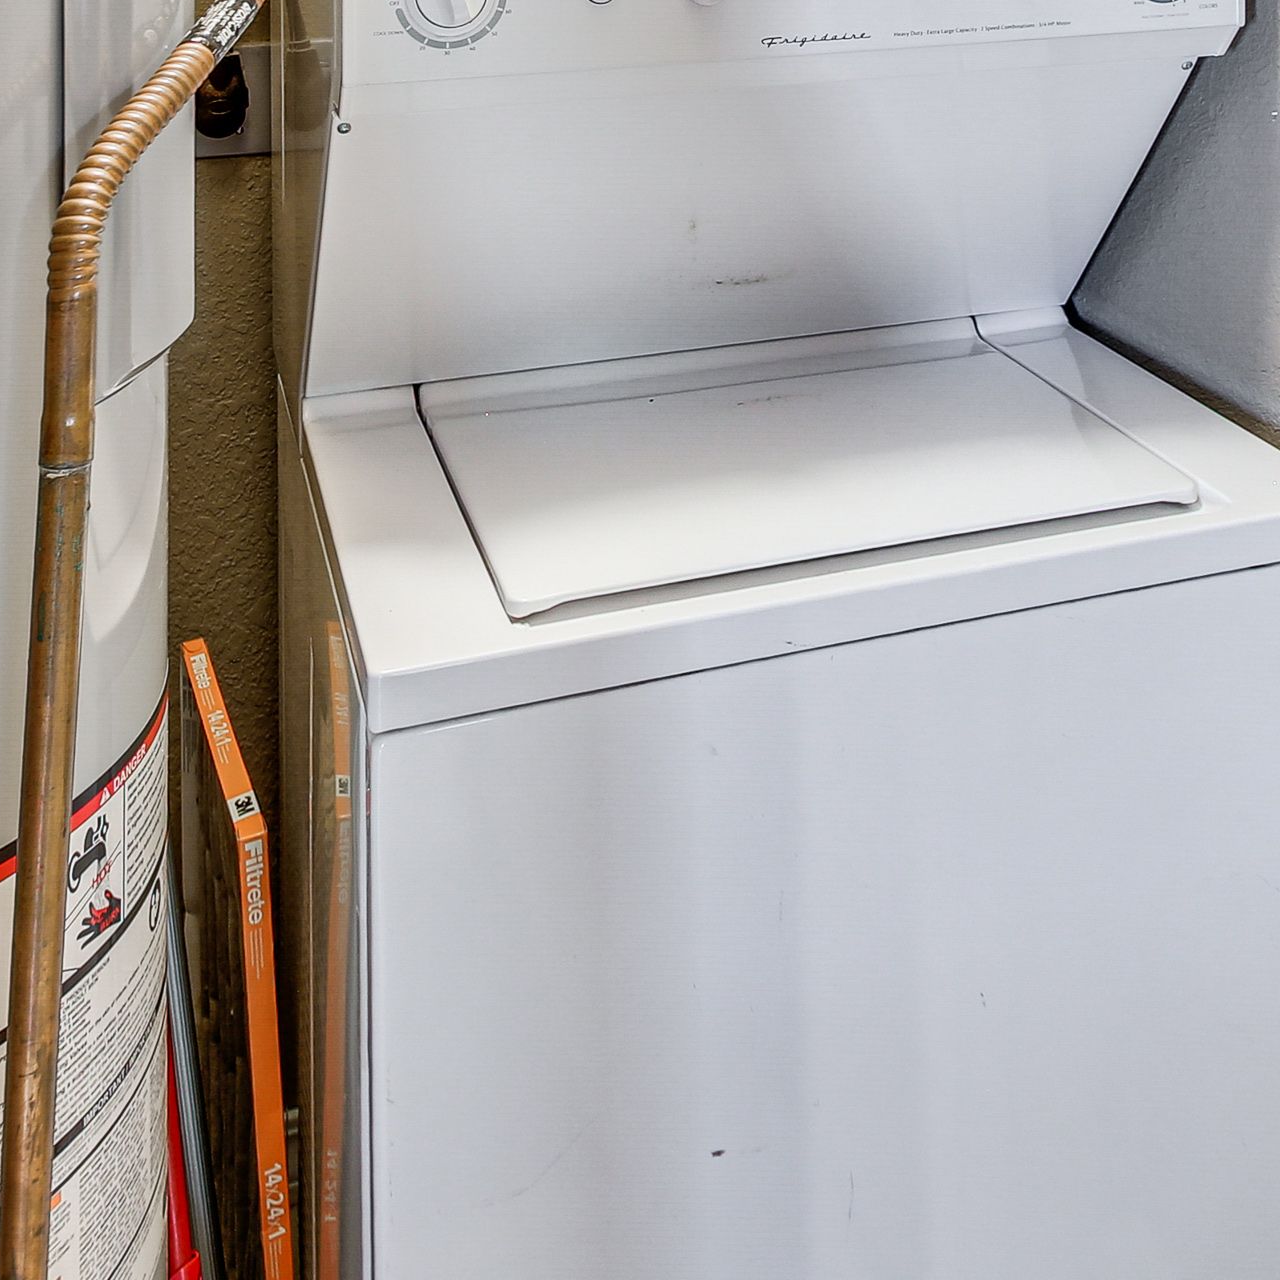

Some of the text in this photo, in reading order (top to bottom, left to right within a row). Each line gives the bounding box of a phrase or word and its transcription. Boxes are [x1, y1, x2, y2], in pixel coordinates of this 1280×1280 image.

[761, 31, 872, 49] Frigidaire
[113, 743, 147, 793] DANGER
[234, 794, 256, 818] 3M
[244, 838, 263, 925] Filtrete
